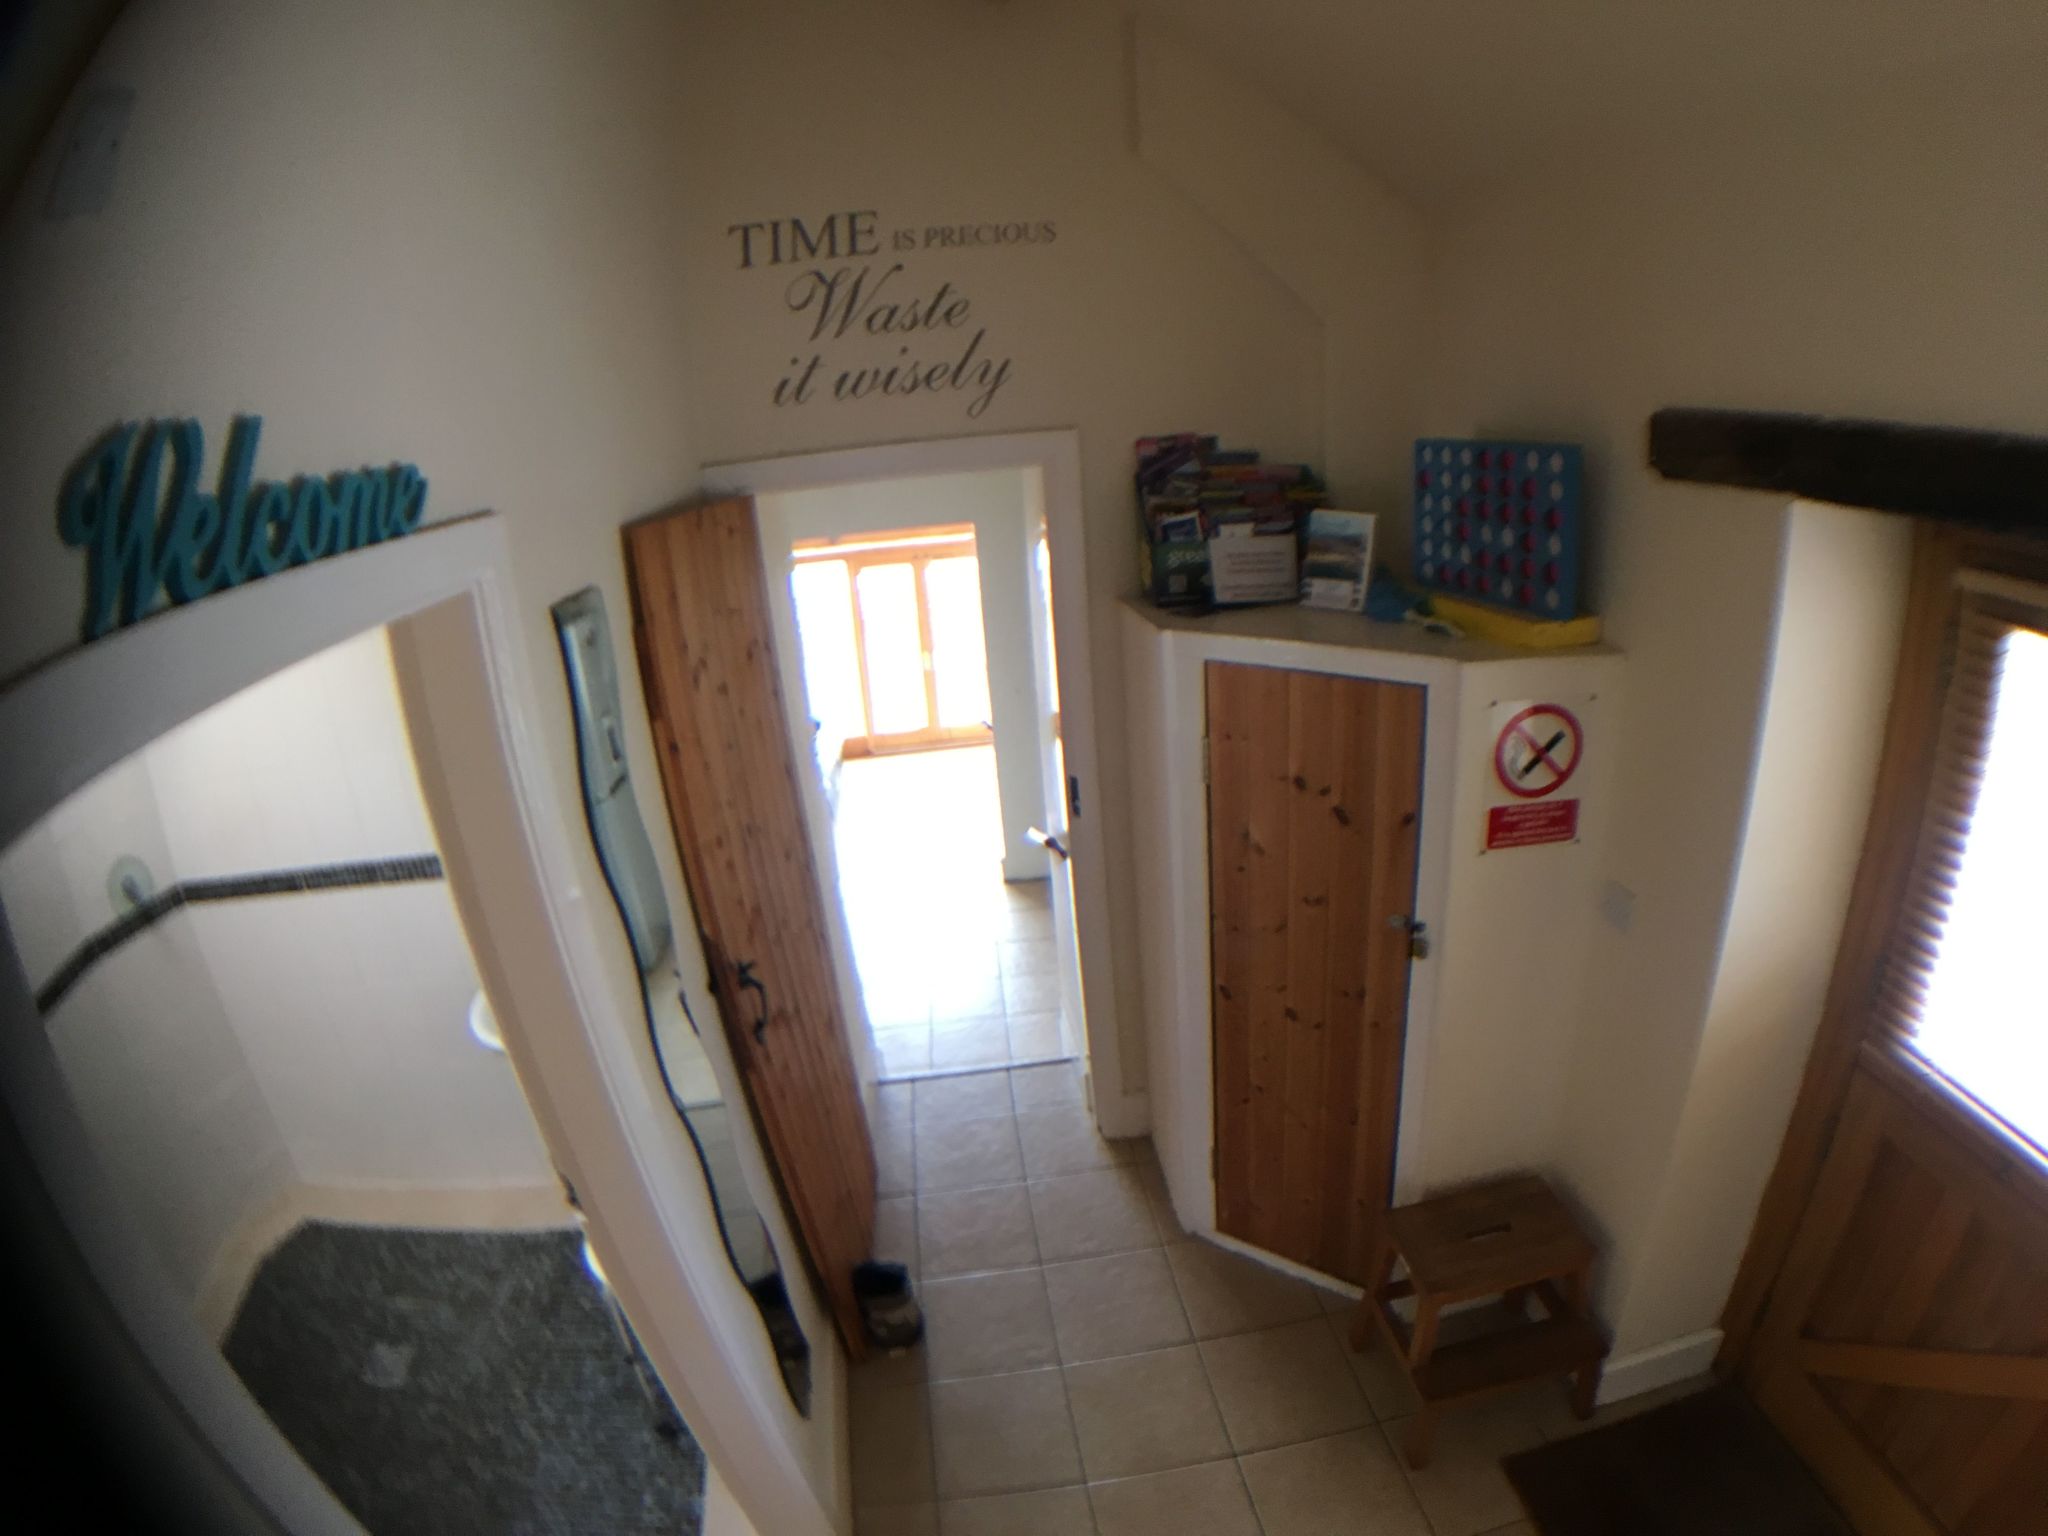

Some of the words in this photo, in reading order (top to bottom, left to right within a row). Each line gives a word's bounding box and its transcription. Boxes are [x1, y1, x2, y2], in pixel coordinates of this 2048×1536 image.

[728, 210, 880, 269] TIME
[892, 229, 916, 251] IS
[923, 220, 1057, 249] PRECIOUS
[784, 263, 971, 342] Waste
[772, 354, 822, 407] it
[834, 328, 1012, 419] wisely
[57, 412, 429, 644] Welcome
